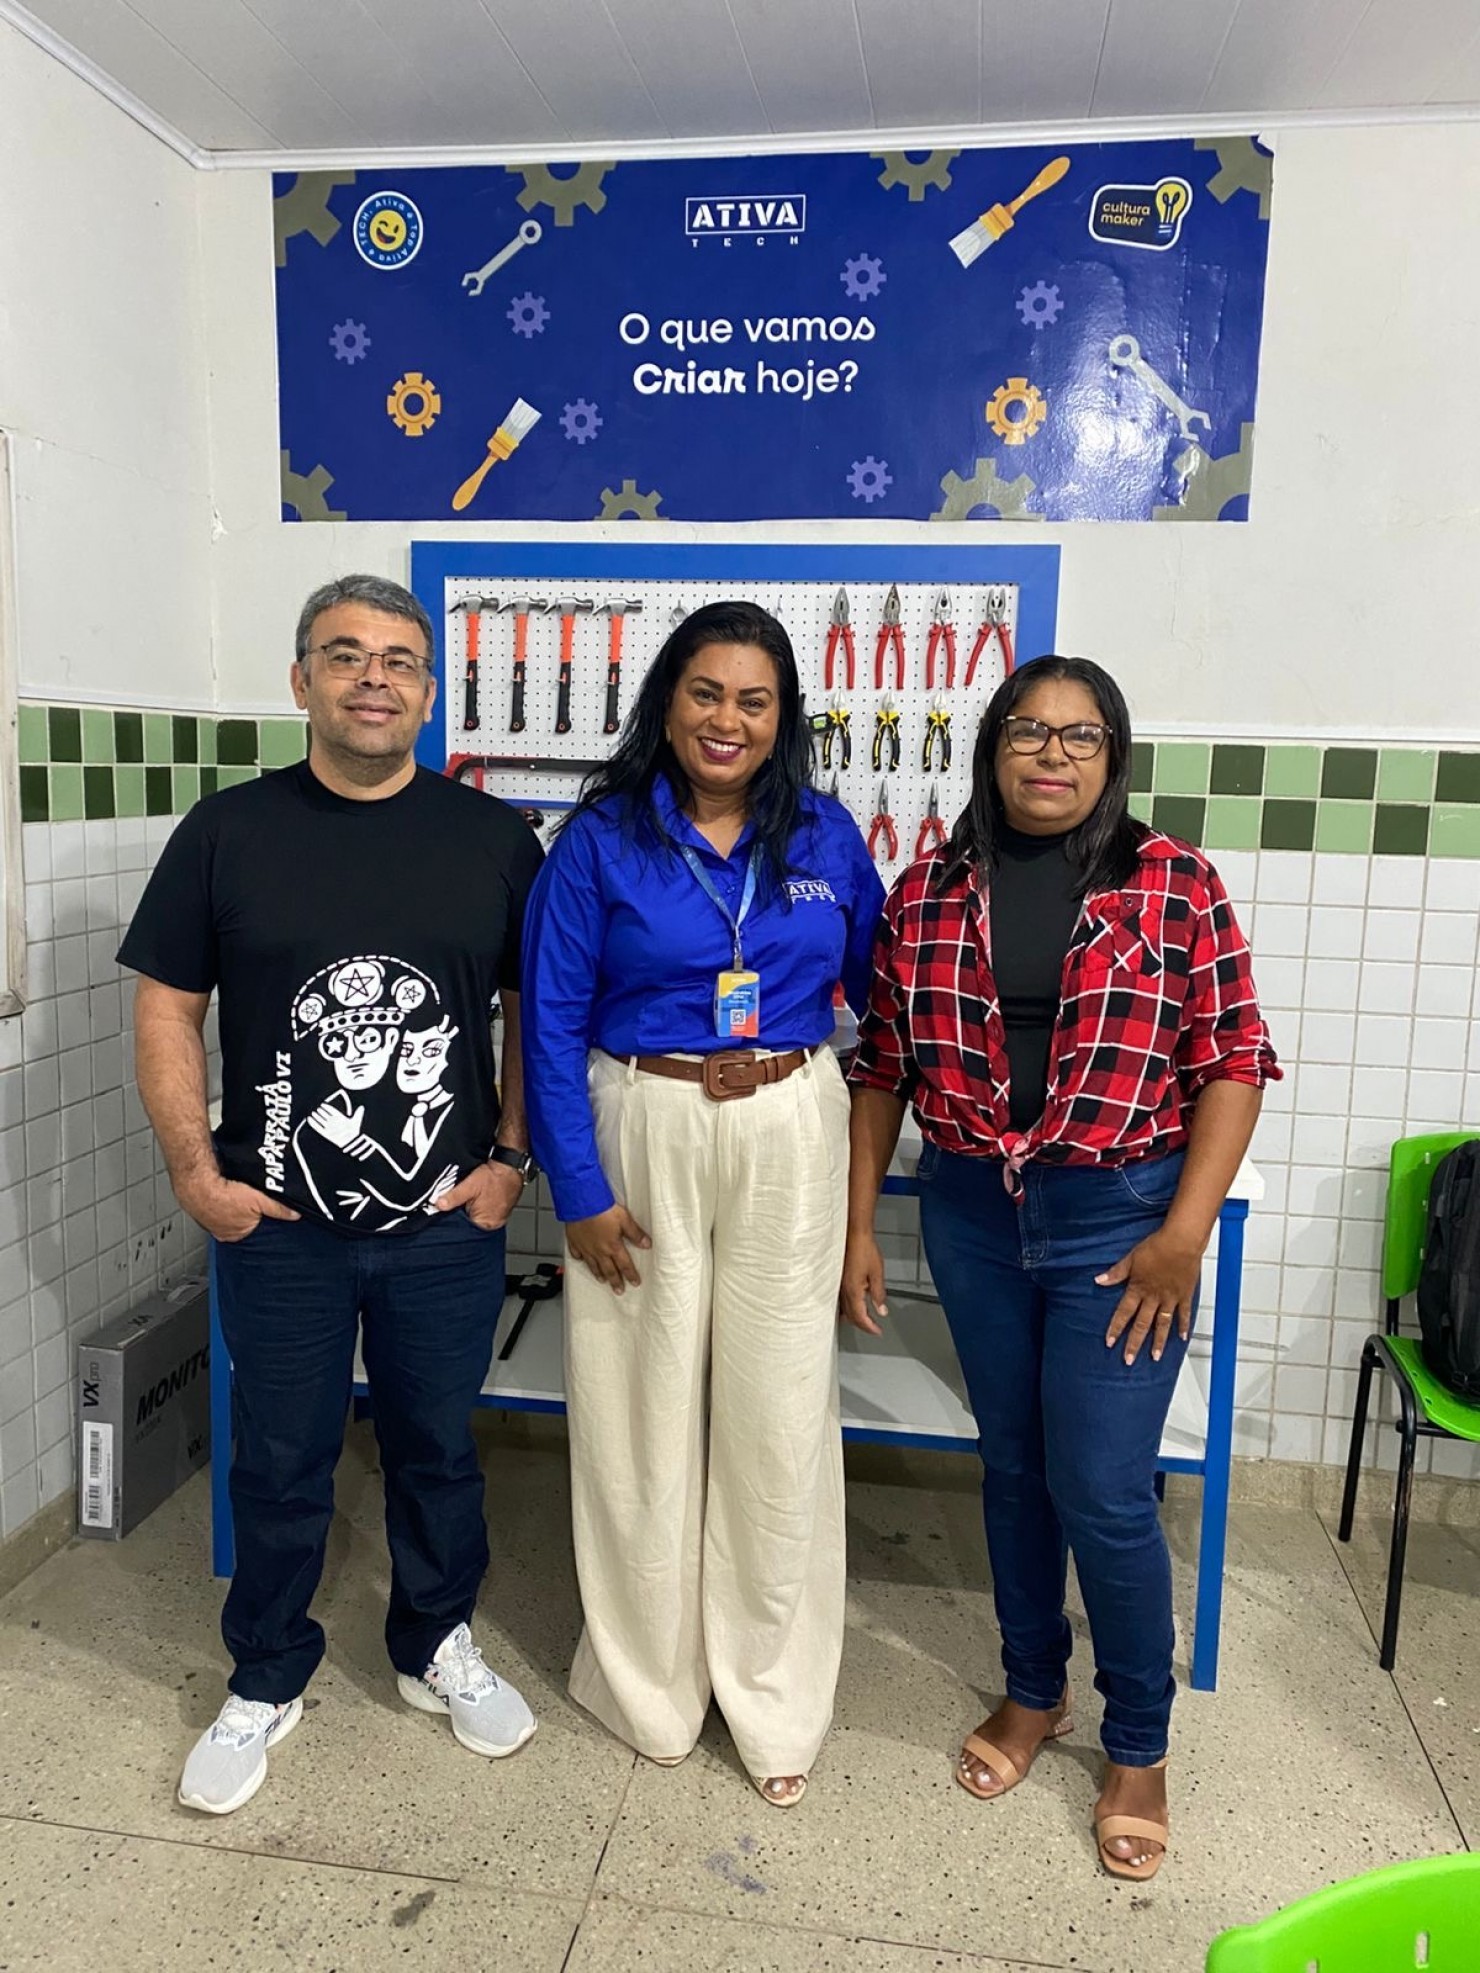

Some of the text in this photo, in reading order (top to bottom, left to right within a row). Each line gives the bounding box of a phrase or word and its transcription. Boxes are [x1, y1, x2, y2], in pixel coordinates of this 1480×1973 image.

[692, 202, 799, 228] ATIVA
[1100, 213, 1145, 227] maker
[1102, 201, 1151, 216] cultura
[691, 235, 799, 249] TECH
[619, 312, 876, 352] O que vamos
[632, 359, 859, 401] Criar hoje?
[275, 1050, 292, 1078] VI
[275, 1079, 292, 1142] PAULO
